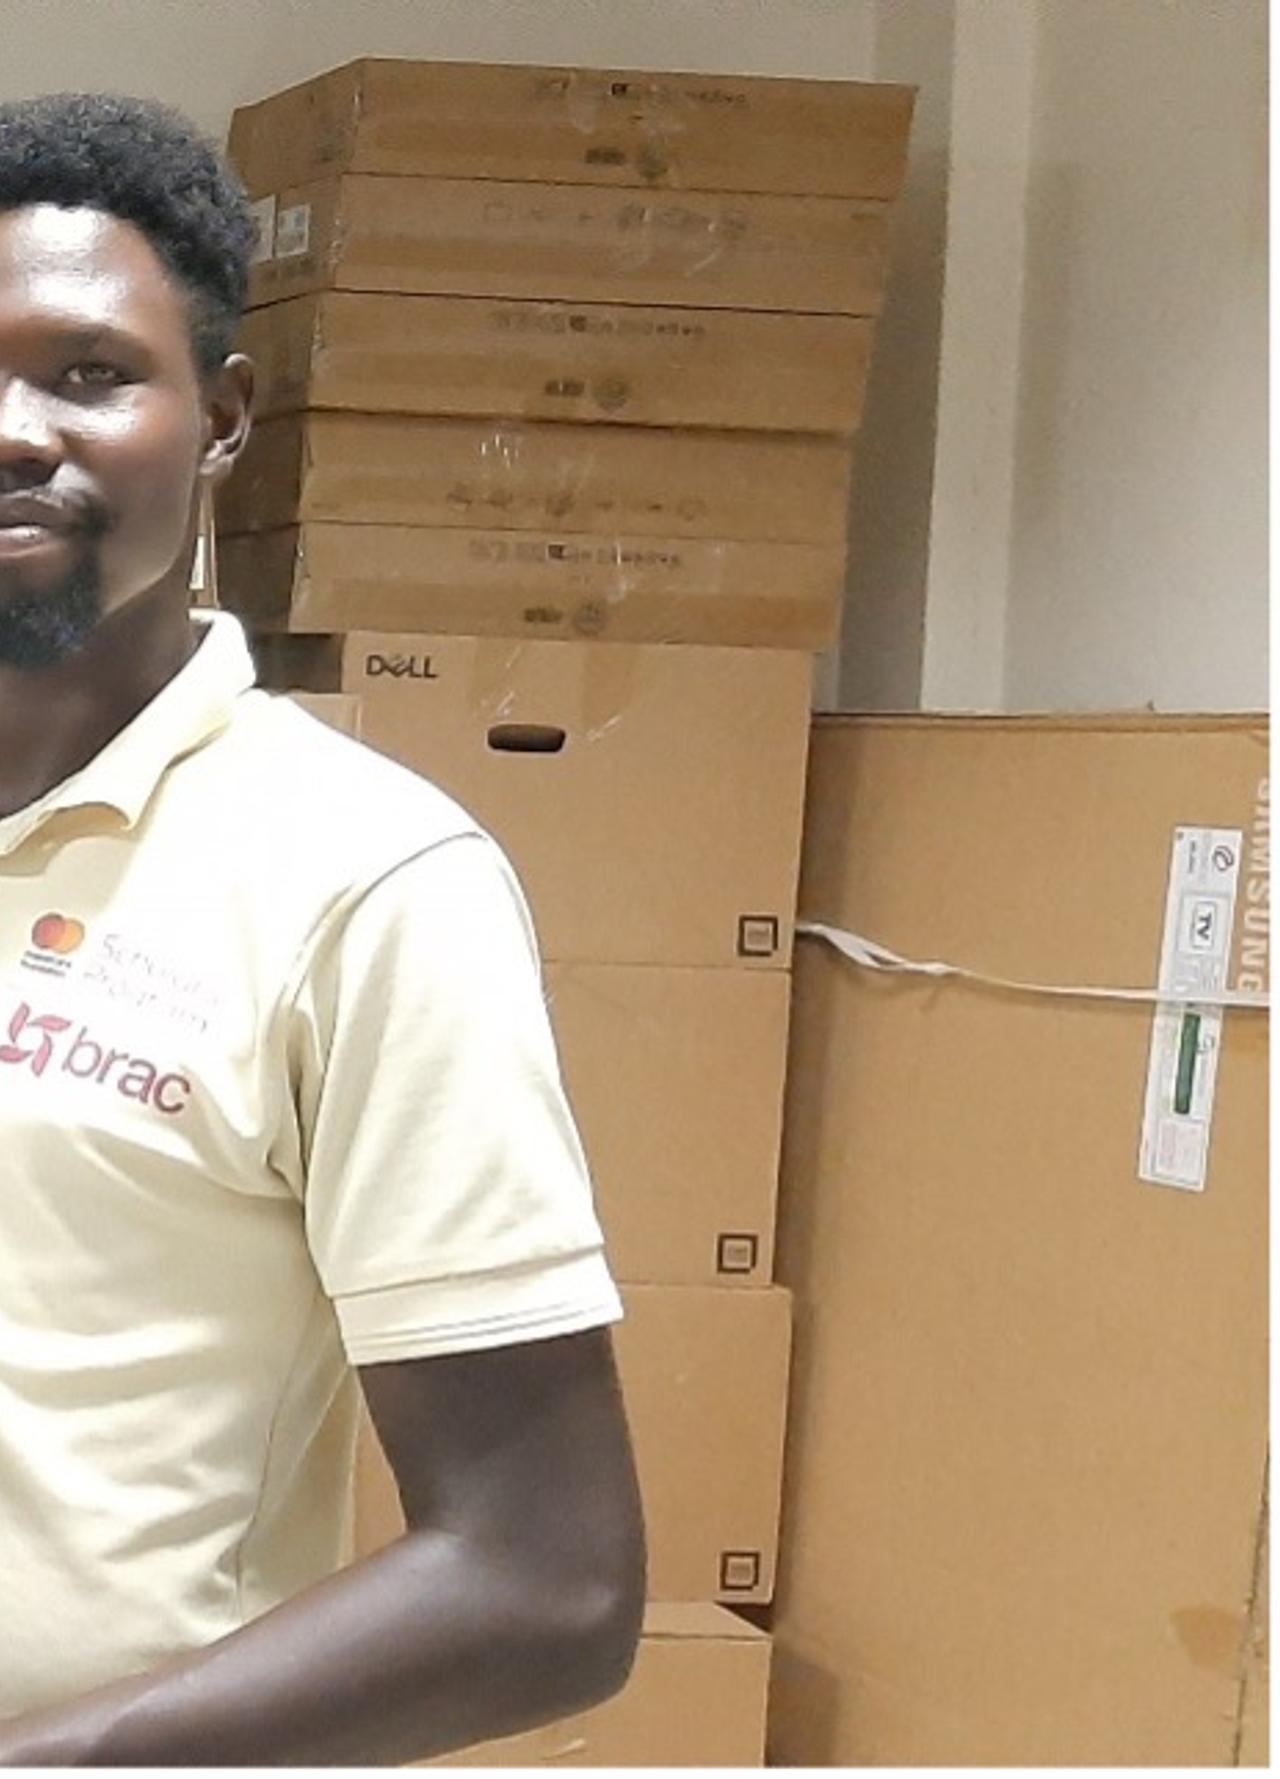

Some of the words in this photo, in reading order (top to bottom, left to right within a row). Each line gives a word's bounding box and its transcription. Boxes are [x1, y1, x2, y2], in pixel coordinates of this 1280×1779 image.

[366, 655, 438, 678] DELL
[1196, 911, 1213, 942] TV
[61, 1025, 191, 1114] brac
